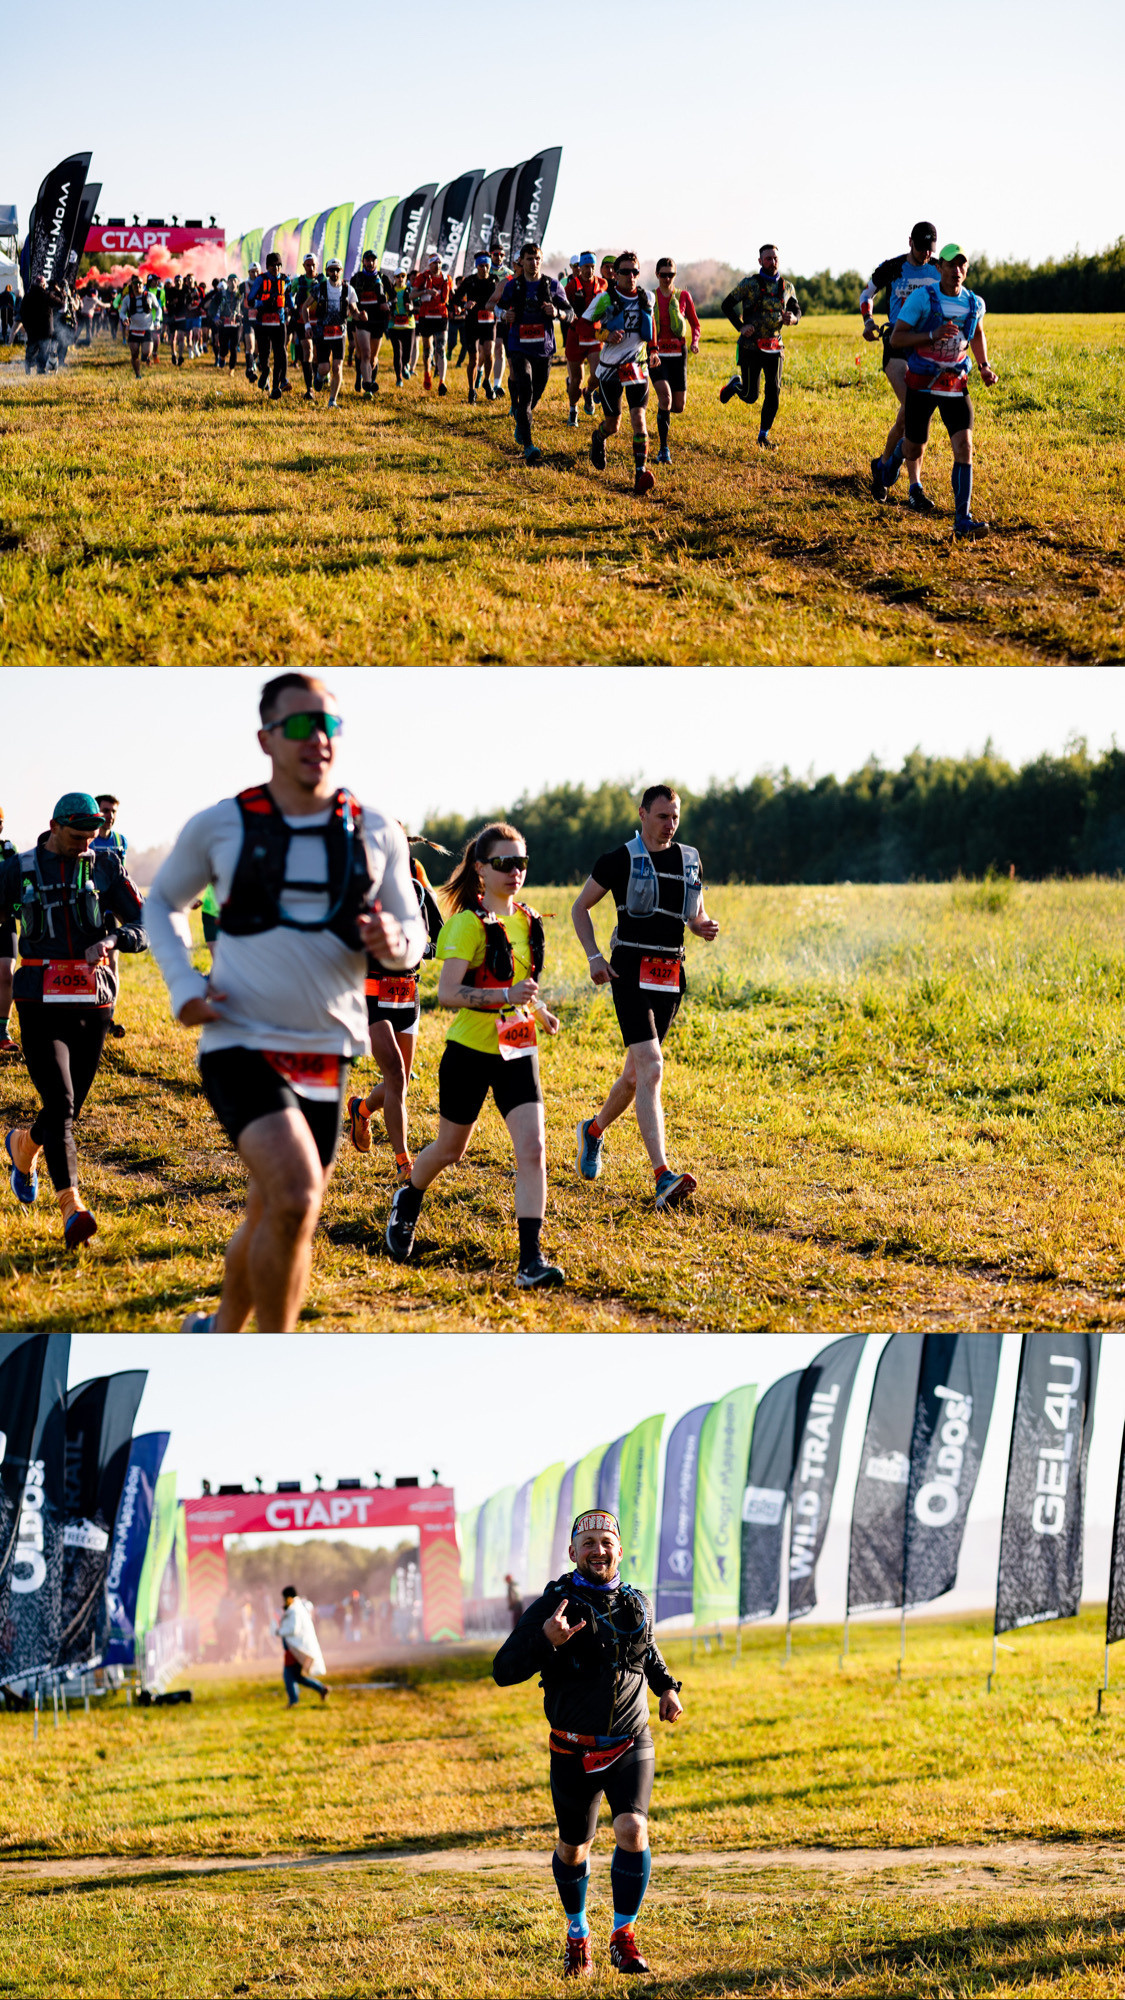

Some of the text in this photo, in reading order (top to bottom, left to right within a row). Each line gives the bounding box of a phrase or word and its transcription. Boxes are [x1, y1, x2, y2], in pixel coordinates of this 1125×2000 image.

[101, 231, 171, 250] СТАРТ
[403, 206, 424, 253] TRAIL
[52, 975, 88, 987] 4055
[649, 968, 672, 978] 4127
[504, 1026, 529, 1042] 4042
[914, 1385, 973, 1528] OLDOS!
[1031, 1354, 1081, 1536] GEL4U
[789, 1383, 840, 1581] WILD TRAIL
[265, 1496, 373, 1528] СТАРТ
